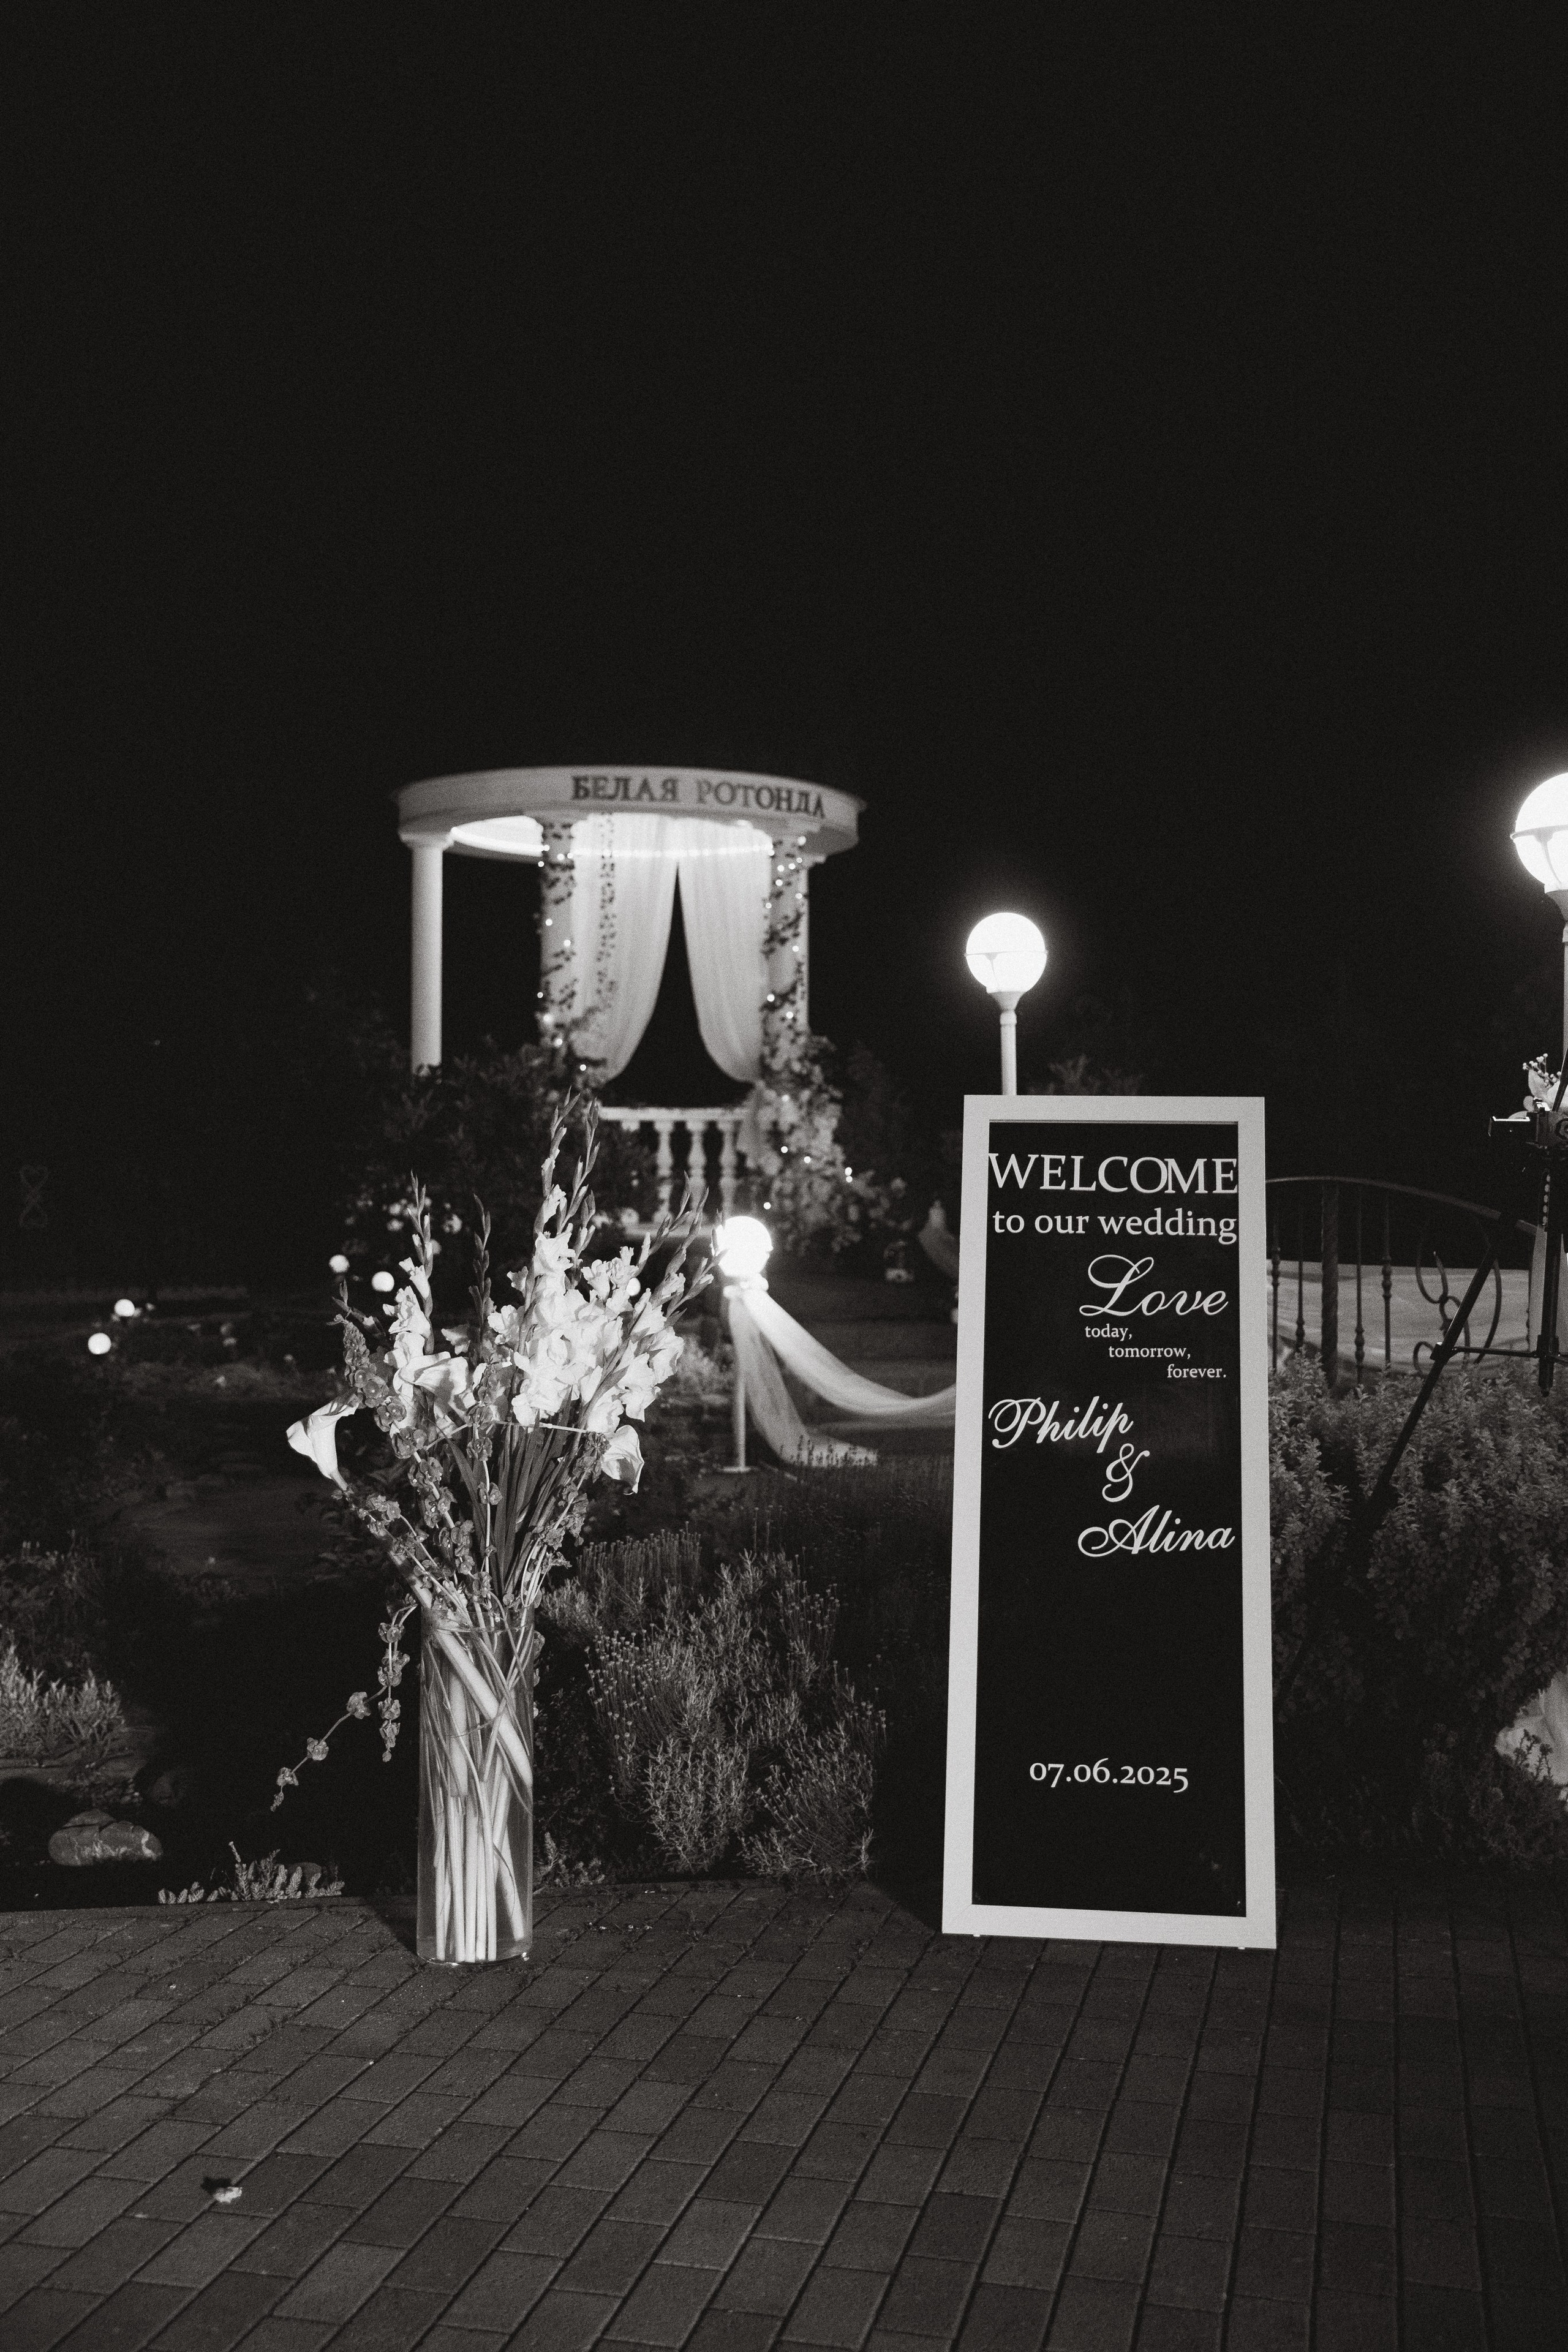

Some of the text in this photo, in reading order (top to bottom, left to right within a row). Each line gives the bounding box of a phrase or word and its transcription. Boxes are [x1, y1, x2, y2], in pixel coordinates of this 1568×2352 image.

[571, 775, 825, 818] БЕЛАЯ РОТОНДА
[989, 1153, 1238, 1194] WELCOME
[993, 1208, 1237, 1245] to our wedding
[1079, 1254, 1229, 1316] Love
[1085, 1324, 1133, 1341] today,
[1109, 1346, 1191, 1359] tomorrow,
[1167, 1364, 1227, 1378] forever.
[988, 1396, 1134, 1453] Philip
[1102, 1443, 1150, 1502] &
[1077, 1505, 1235, 1558] Alina
[1030, 1758, 1189, 1793] 07.06.2025
